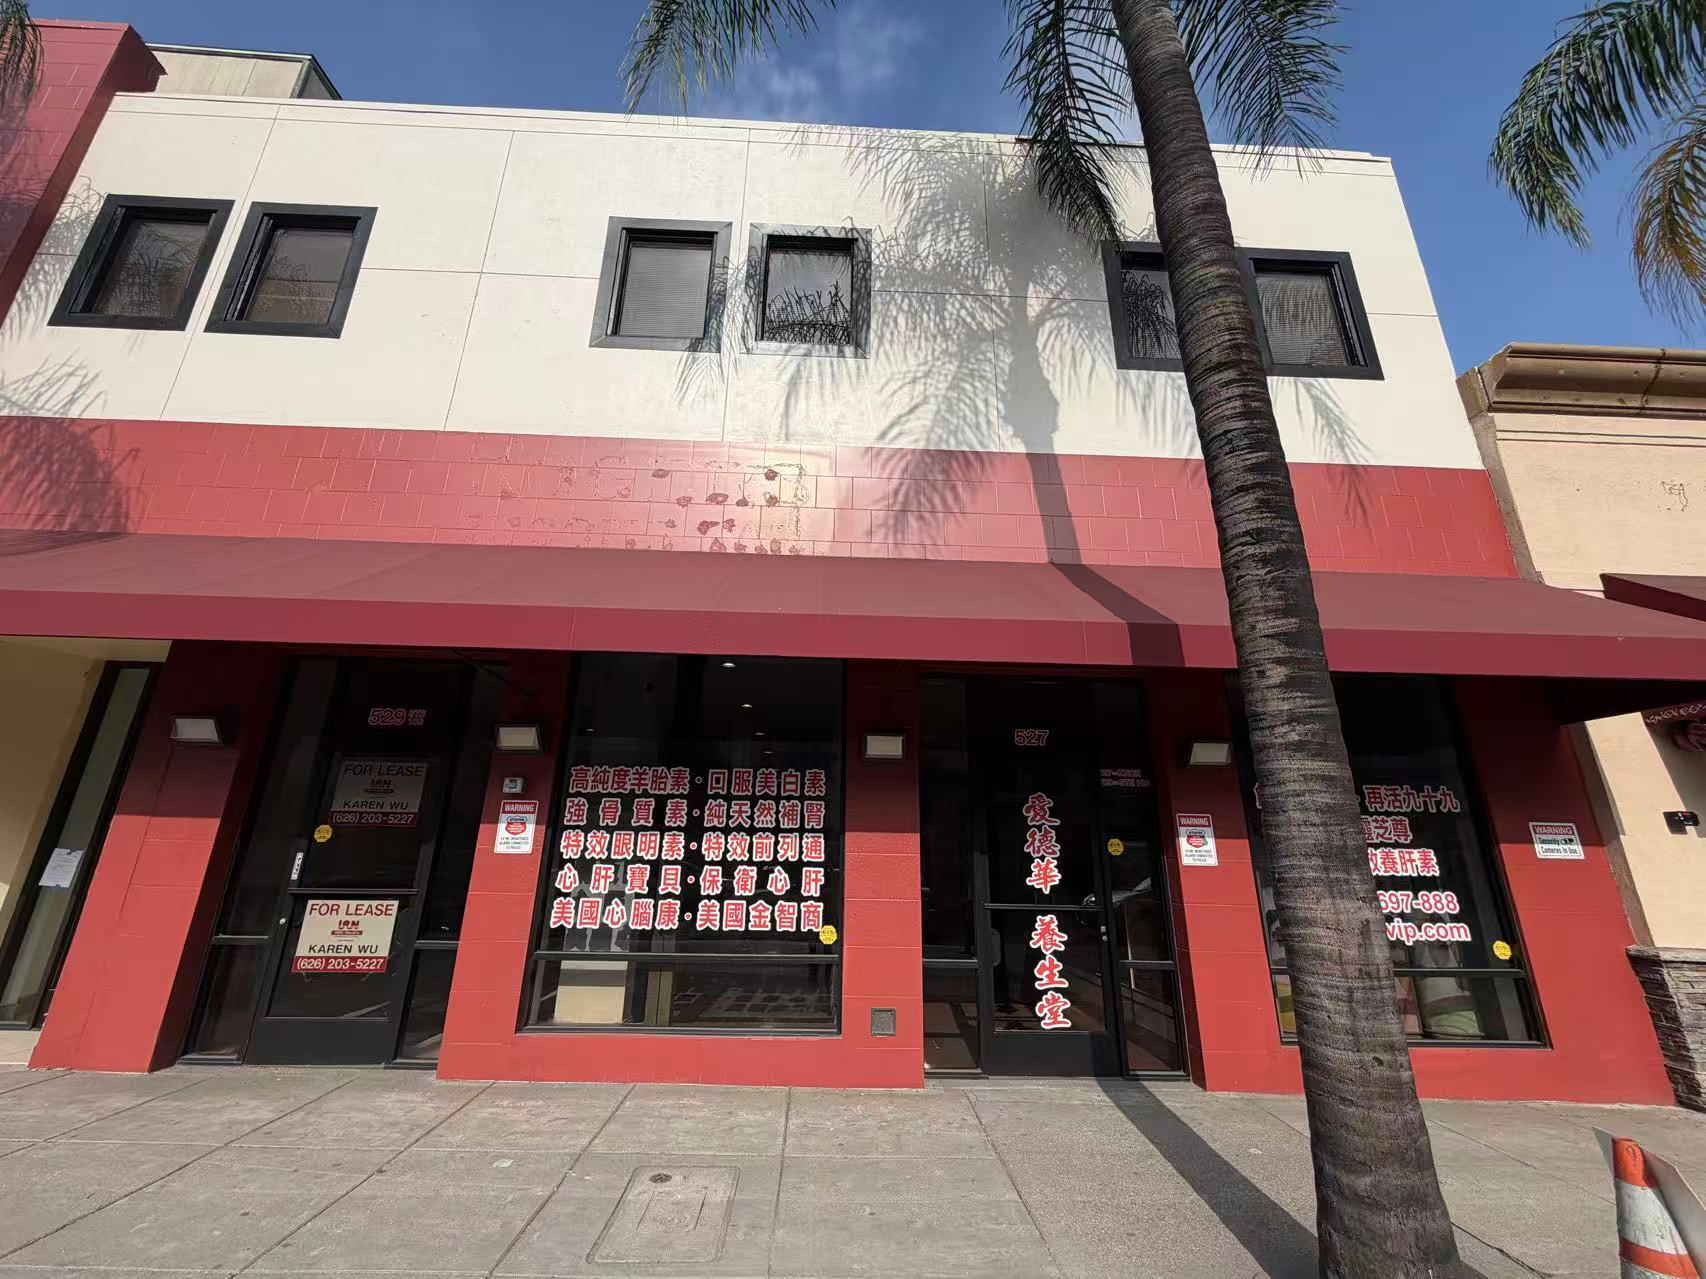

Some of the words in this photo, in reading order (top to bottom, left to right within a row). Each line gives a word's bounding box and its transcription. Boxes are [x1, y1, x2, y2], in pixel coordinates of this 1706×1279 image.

[368, 707, 407, 726] 529
[1014, 728, 1050, 747] 527
[343, 764, 373, 777] FOR
[377, 764, 424, 777] LEASE
[343, 800, 385, 810] KAREN
[389, 801, 409, 811] WU
[504, 803, 535, 813] WARNING
[332, 812, 360, 825] (626)
[361, 813, 416, 825] 203-5227
[1180, 817, 1209, 826] WARNING
[1534, 826, 1573, 835] WARNING
[1538, 837, 1560, 846] Security
[1540, 846, 1562, 854] Cameras
[309, 903, 341, 917] FOR
[344, 903, 395, 917] LEASE
[308, 944, 353, 954] KAREN
[357, 945, 379, 954] WU
[296, 957, 326, 970] (626)
[326, 958, 385, 970] 203-5227
